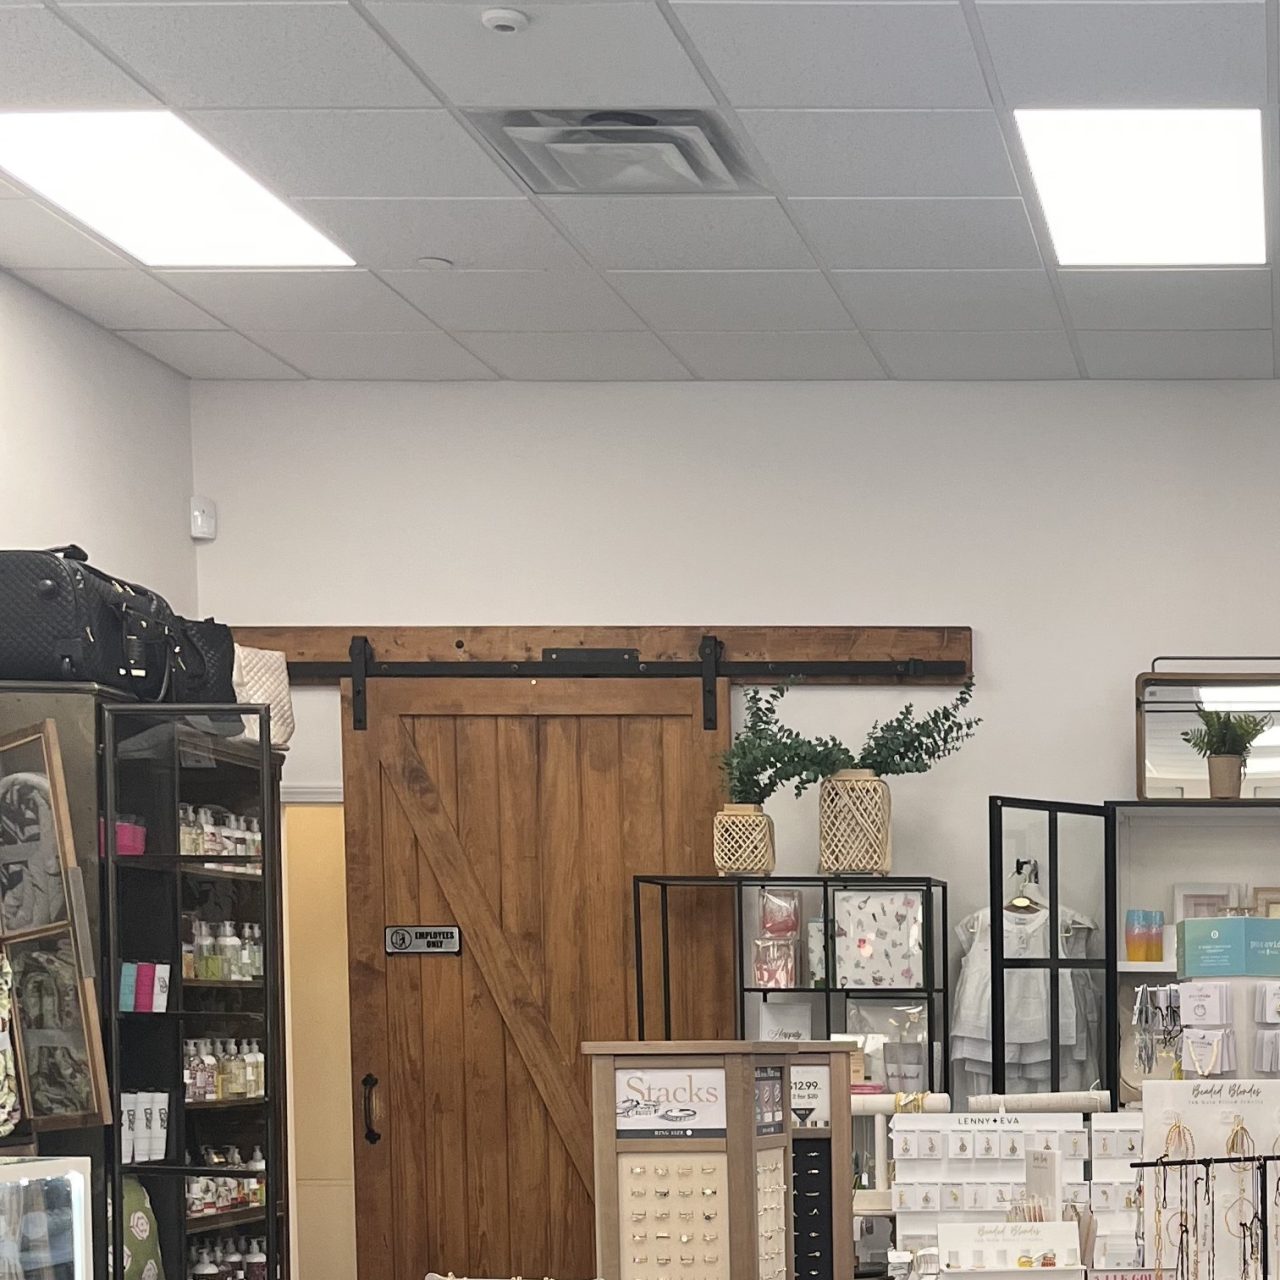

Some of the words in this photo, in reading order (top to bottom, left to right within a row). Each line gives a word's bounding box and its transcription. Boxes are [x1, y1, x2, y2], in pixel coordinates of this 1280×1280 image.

[414, 931, 455, 940] EMPLOYEES
[426, 940, 444, 948] ONLY
[626, 1074, 720, 1104] Stacks
[958, 1117, 990, 1125] LENNY
[1000, 1117, 1020, 1125] EVA
